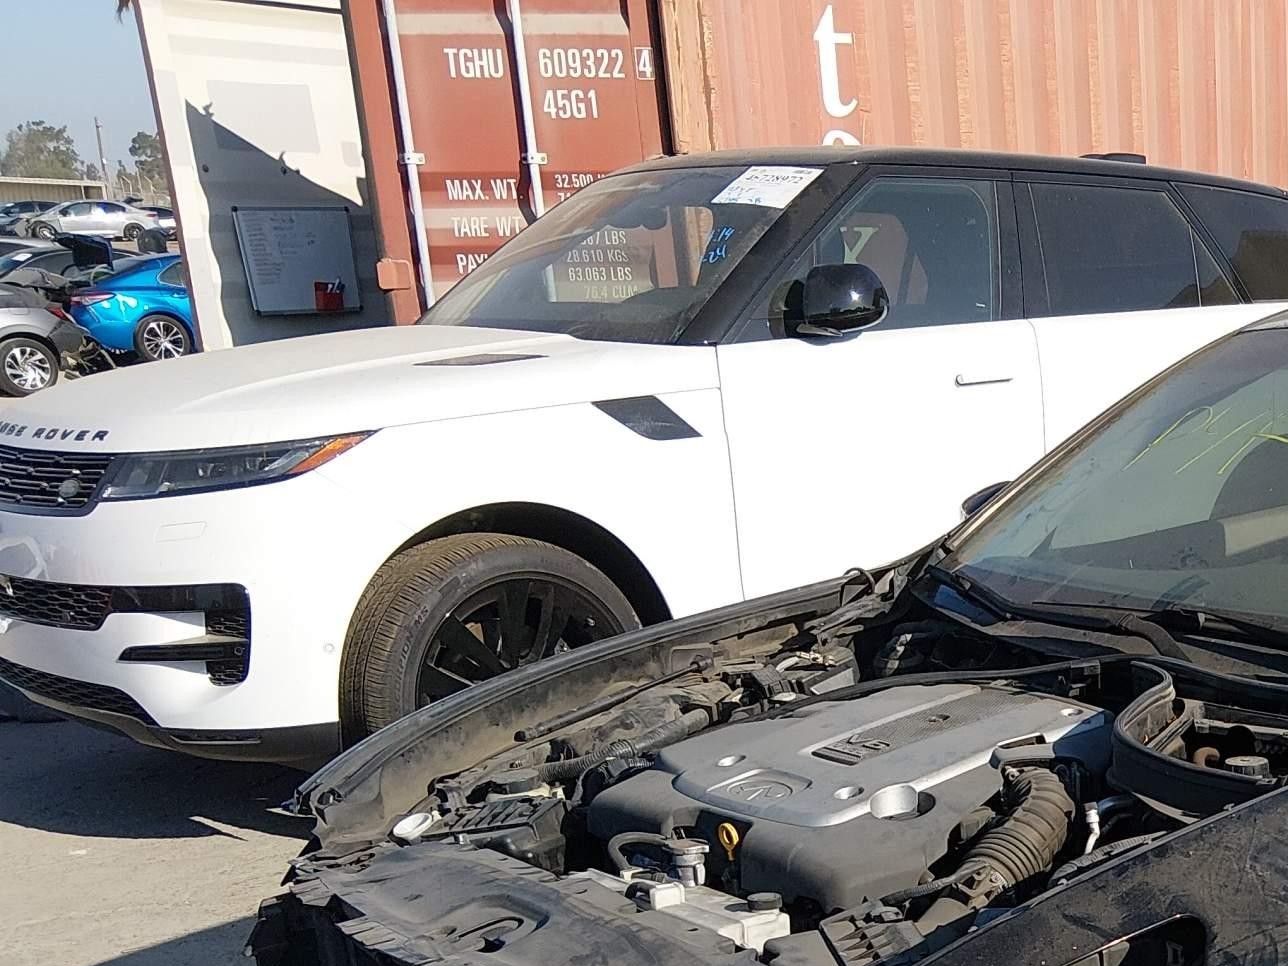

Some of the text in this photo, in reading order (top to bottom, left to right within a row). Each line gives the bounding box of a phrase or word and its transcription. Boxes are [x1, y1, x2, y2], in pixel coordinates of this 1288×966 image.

[443, 48, 653, 79] TGHU 609322 4
[543, 90, 599, 119] 45G1
[446, 179, 489, 200] MAX.
[451, 216, 489, 237] TARE
[604, 231, 627, 245] LBS
[607, 249, 630, 263] KGS
[568, 266, 633, 281] 63.063 LBS
[0, 421, 109, 441] NGE ROVER
